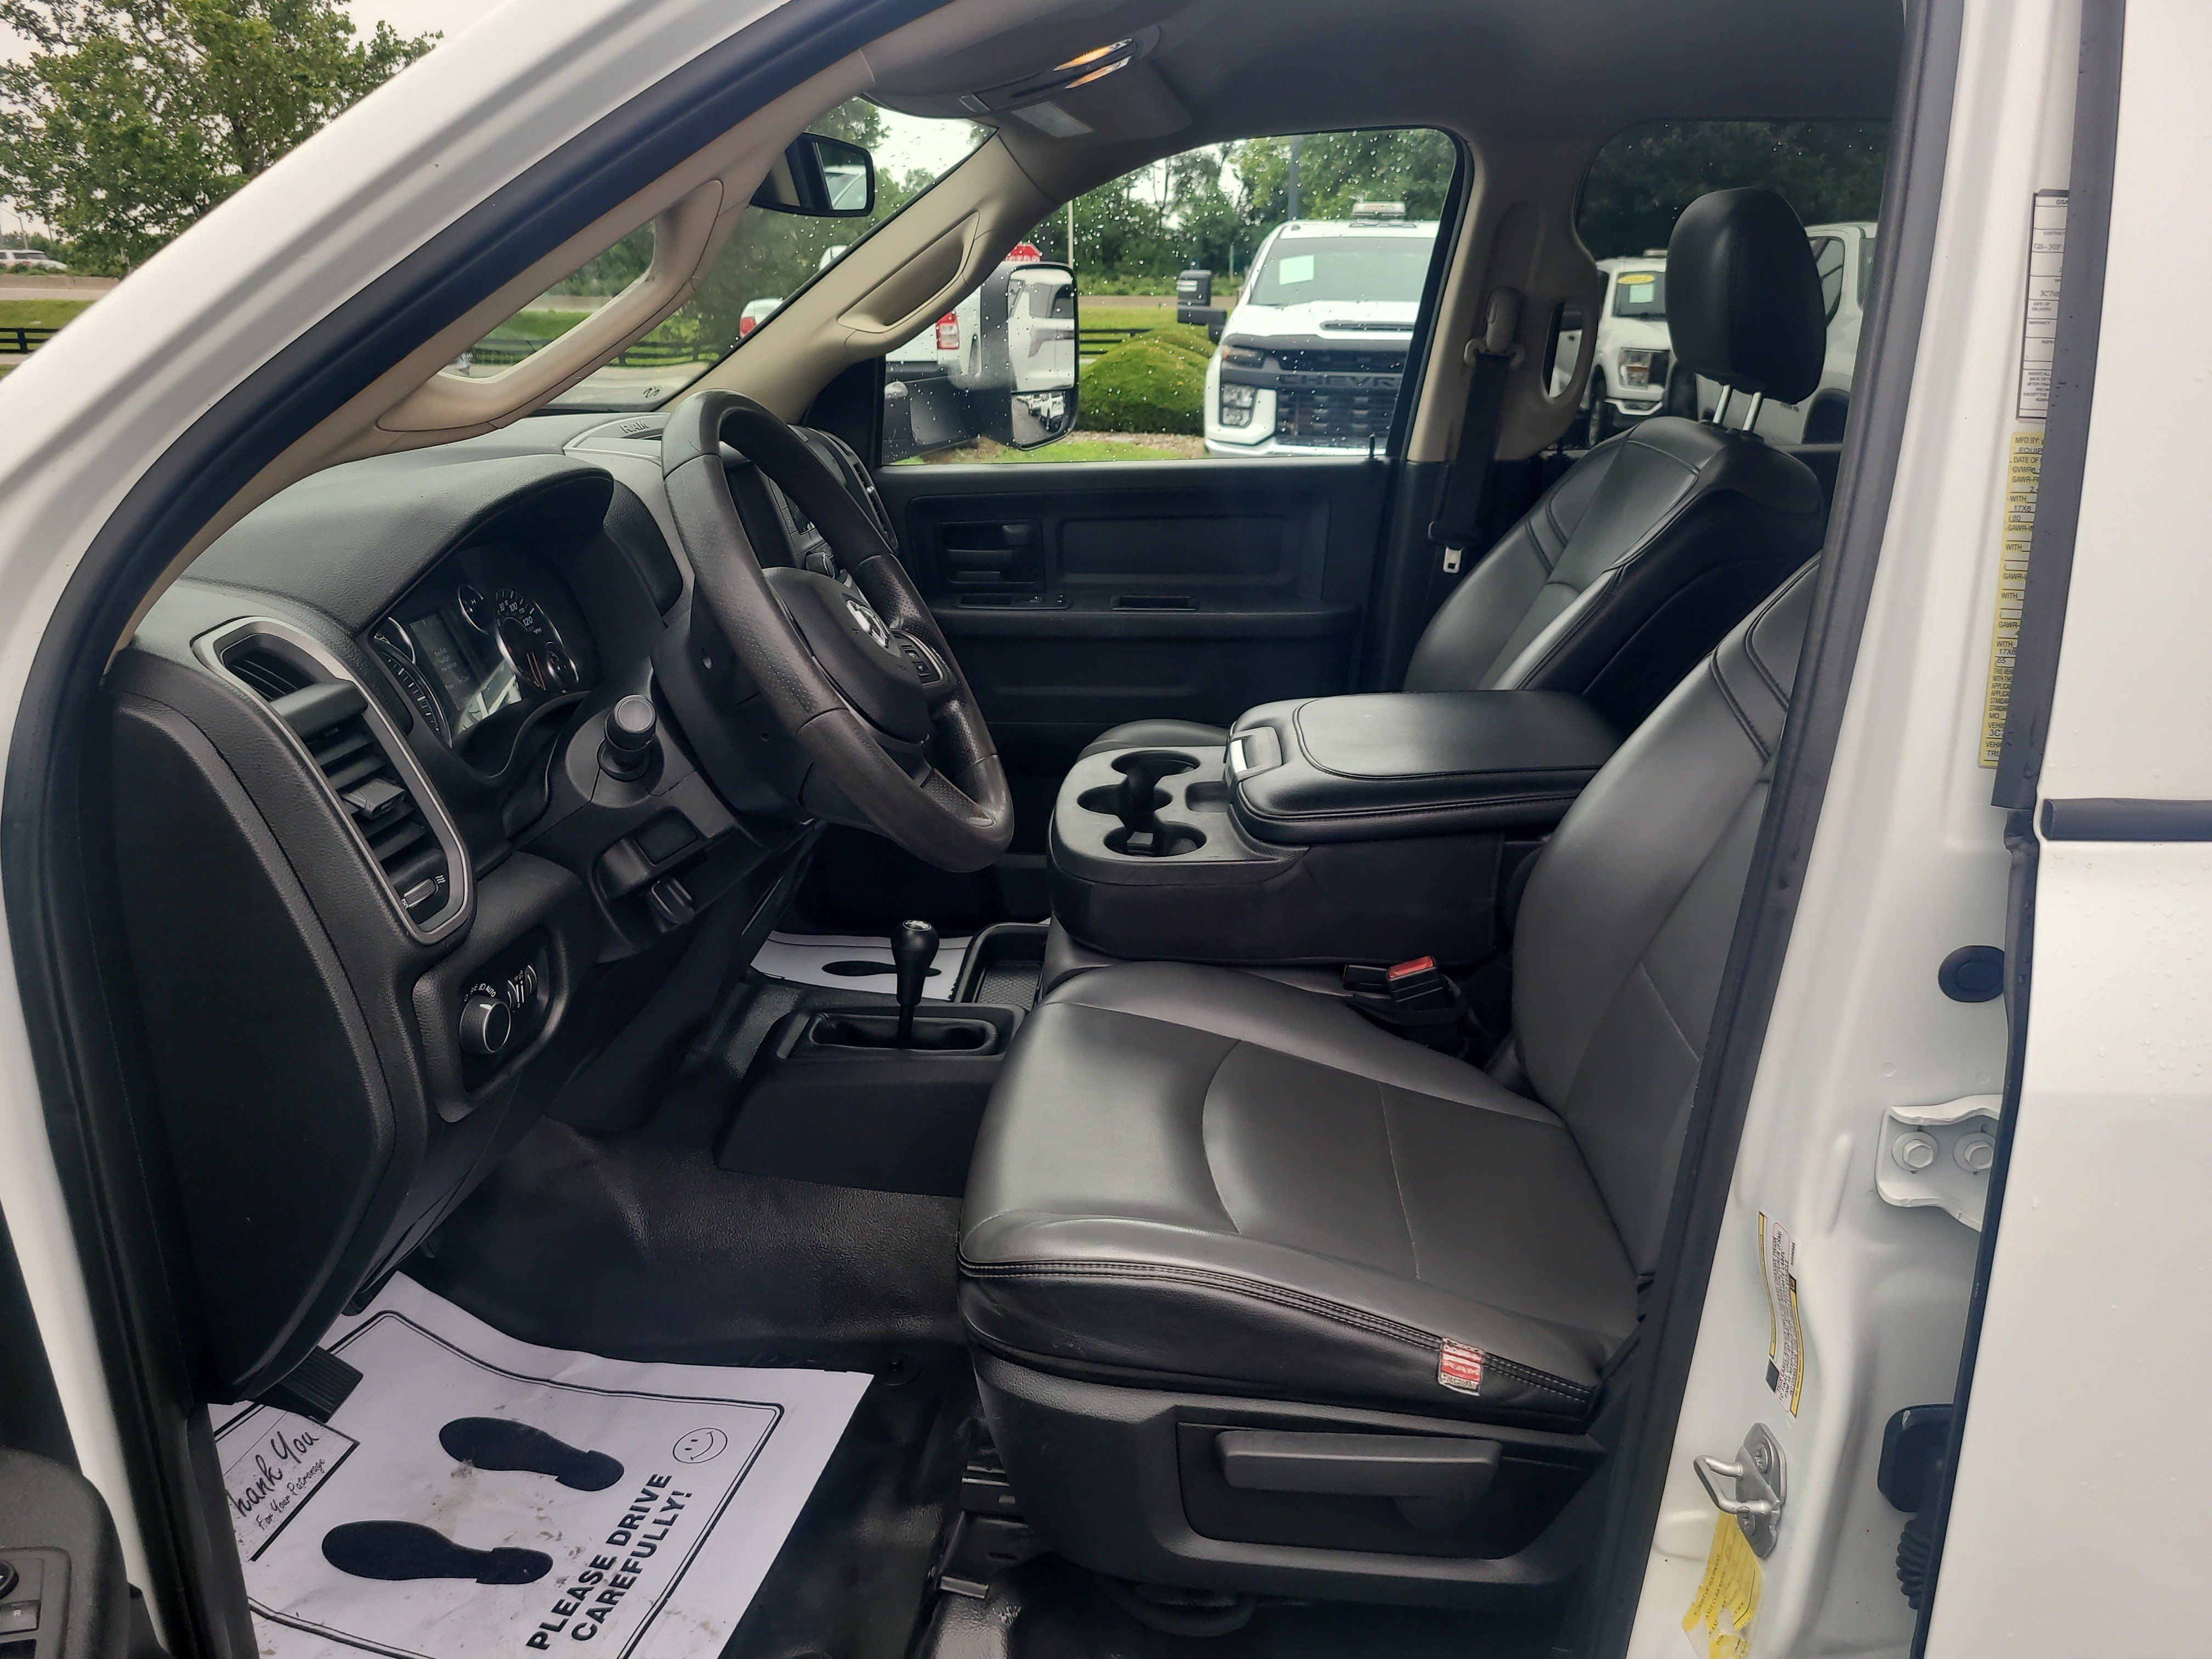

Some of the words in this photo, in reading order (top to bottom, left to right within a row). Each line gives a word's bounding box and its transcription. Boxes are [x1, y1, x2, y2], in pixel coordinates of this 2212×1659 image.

[619, 420, 650, 434] RAM
[509, 602, 518, 613] 100
[522, 616, 533, 627] 120
[485, 985, 496, 997] AUTO
[226, 1454, 284, 1517] hank
[271, 1431, 320, 1464] You
[256, 1513, 273, 1530] For
[270, 1495, 291, 1513] Your
[526, 1554, 618, 1650] PLEASE
[605, 1474, 673, 1546] DRIVE
[571, 1489, 693, 1641] CAREFULLY!
